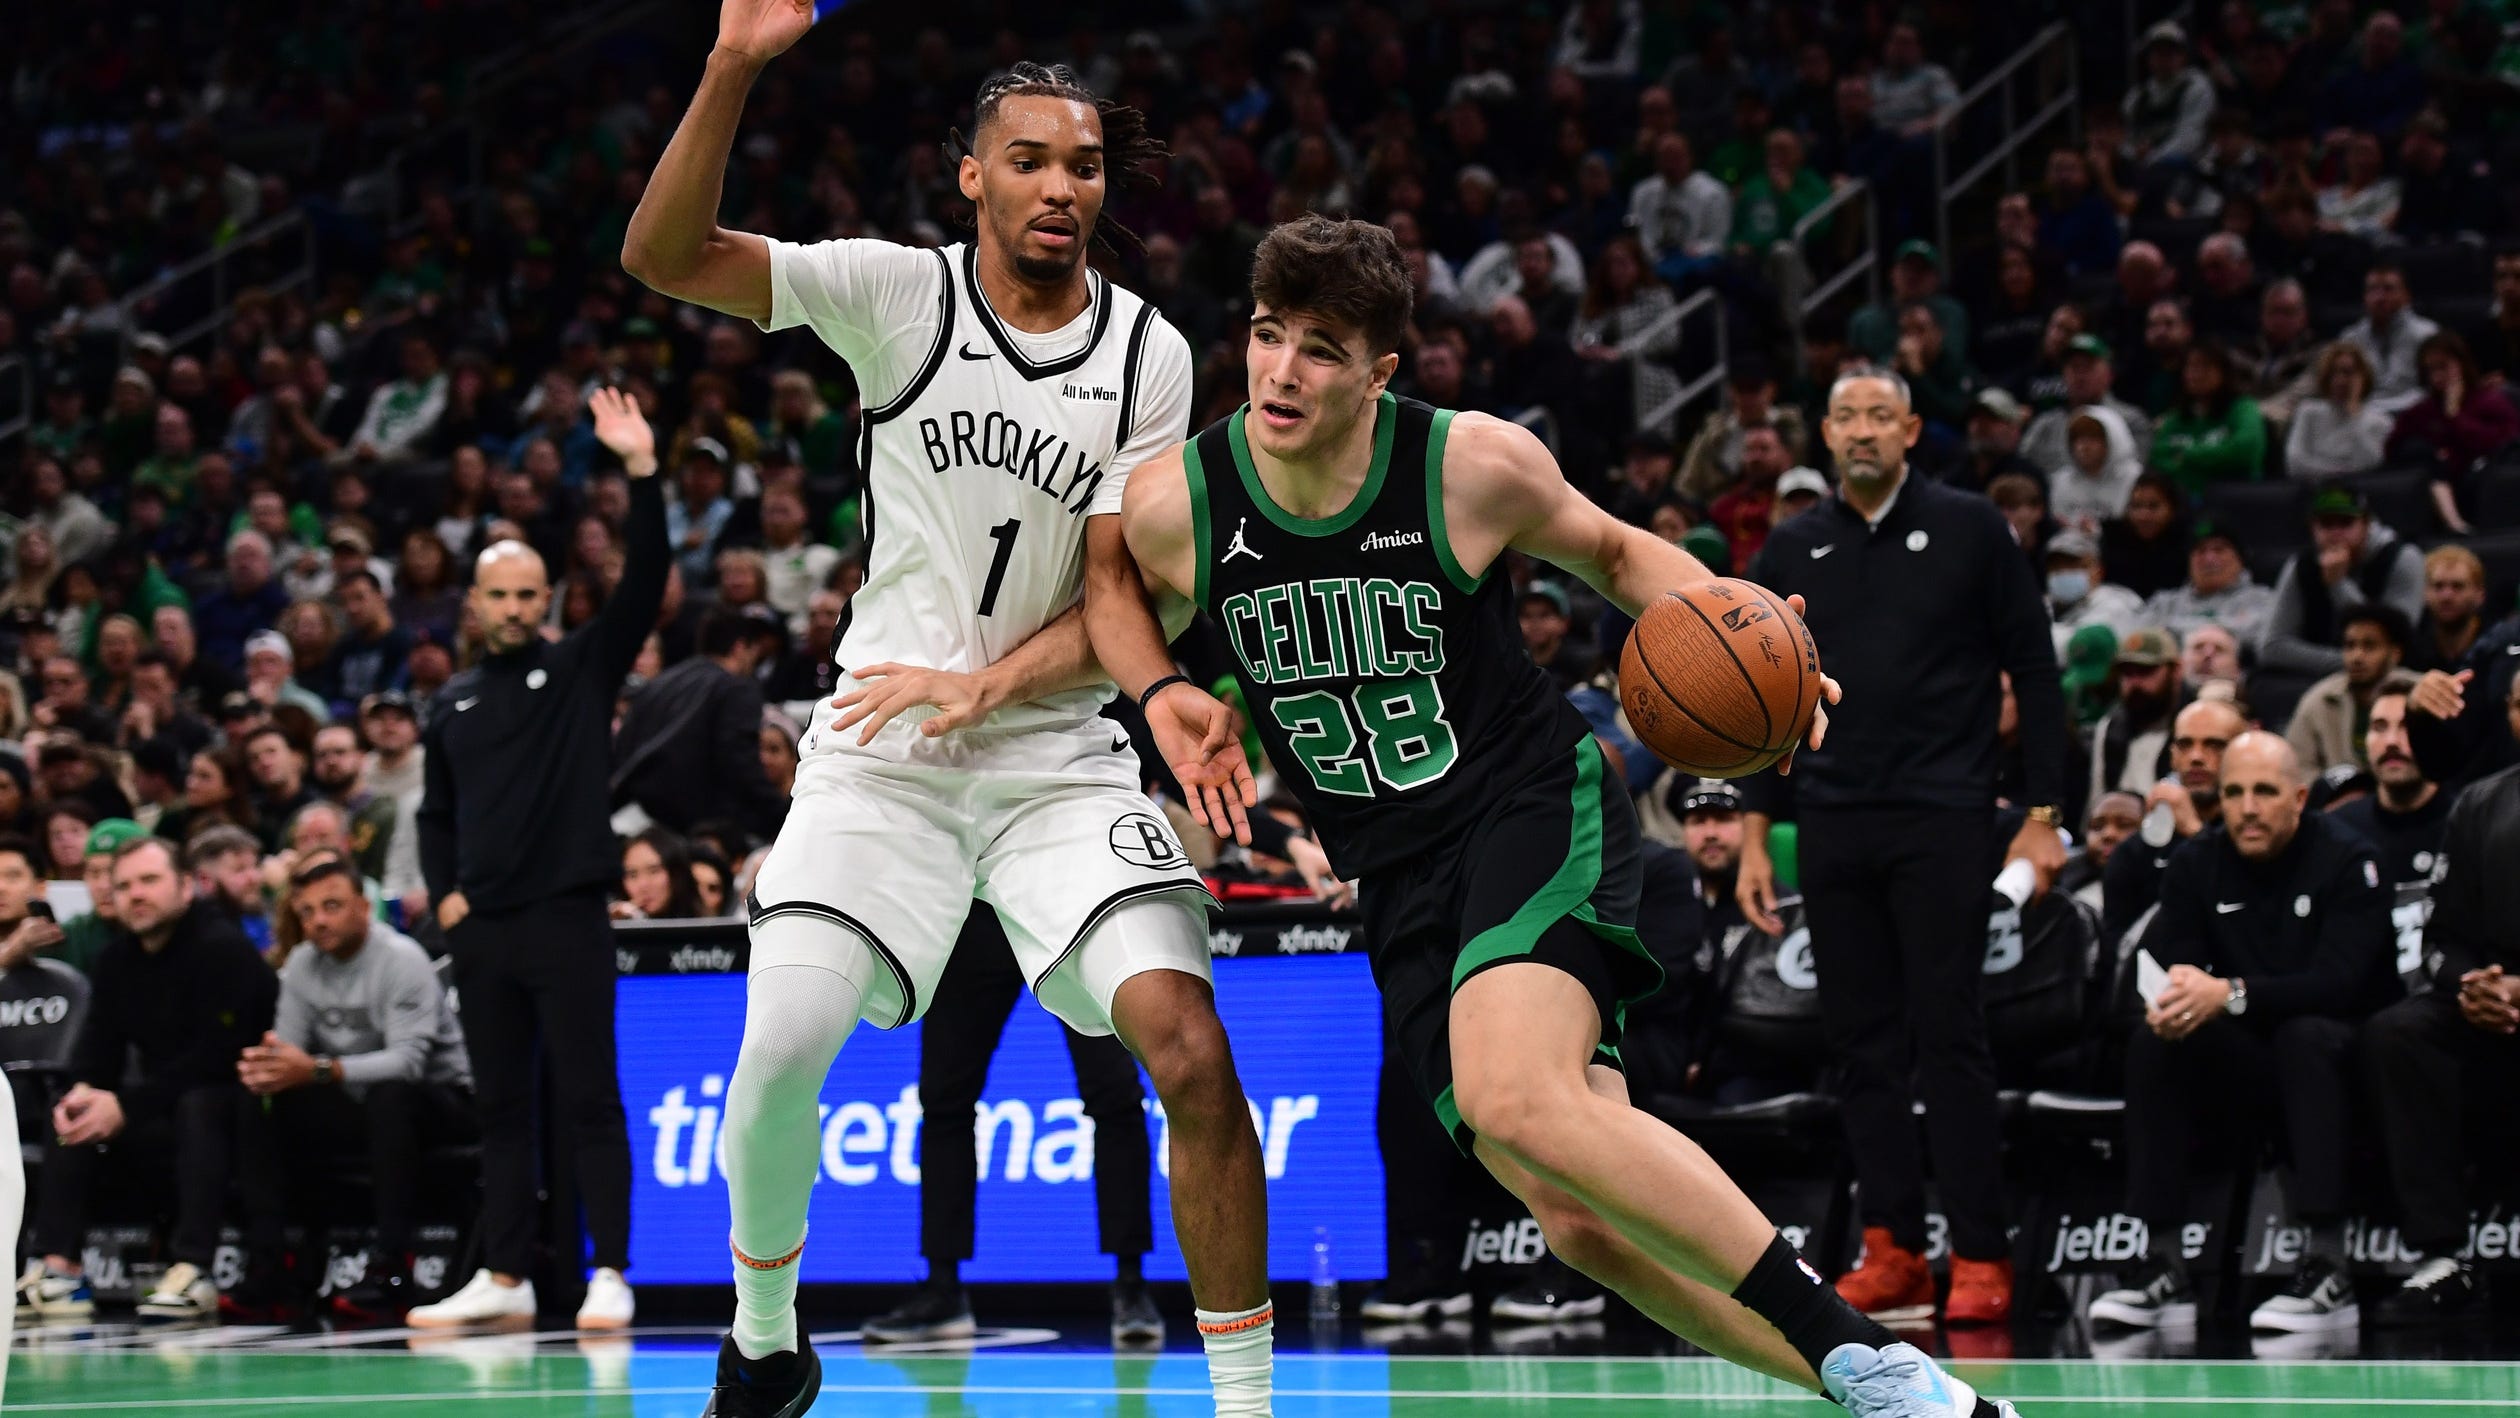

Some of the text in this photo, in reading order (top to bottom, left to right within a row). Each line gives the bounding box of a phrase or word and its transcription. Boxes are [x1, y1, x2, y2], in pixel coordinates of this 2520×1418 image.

[1062, 383, 1117, 401] All In Won
[1360, 530, 1423, 551] Amica
[977, 517, 1022, 617] 1
[1222, 578, 1446, 684] CELTICS
[1270, 675, 1458, 798] 28
[1136, 821, 1174, 860] B
[1277, 924, 1351, 955] xfinity
[669, 944, 736, 974] xfinity
